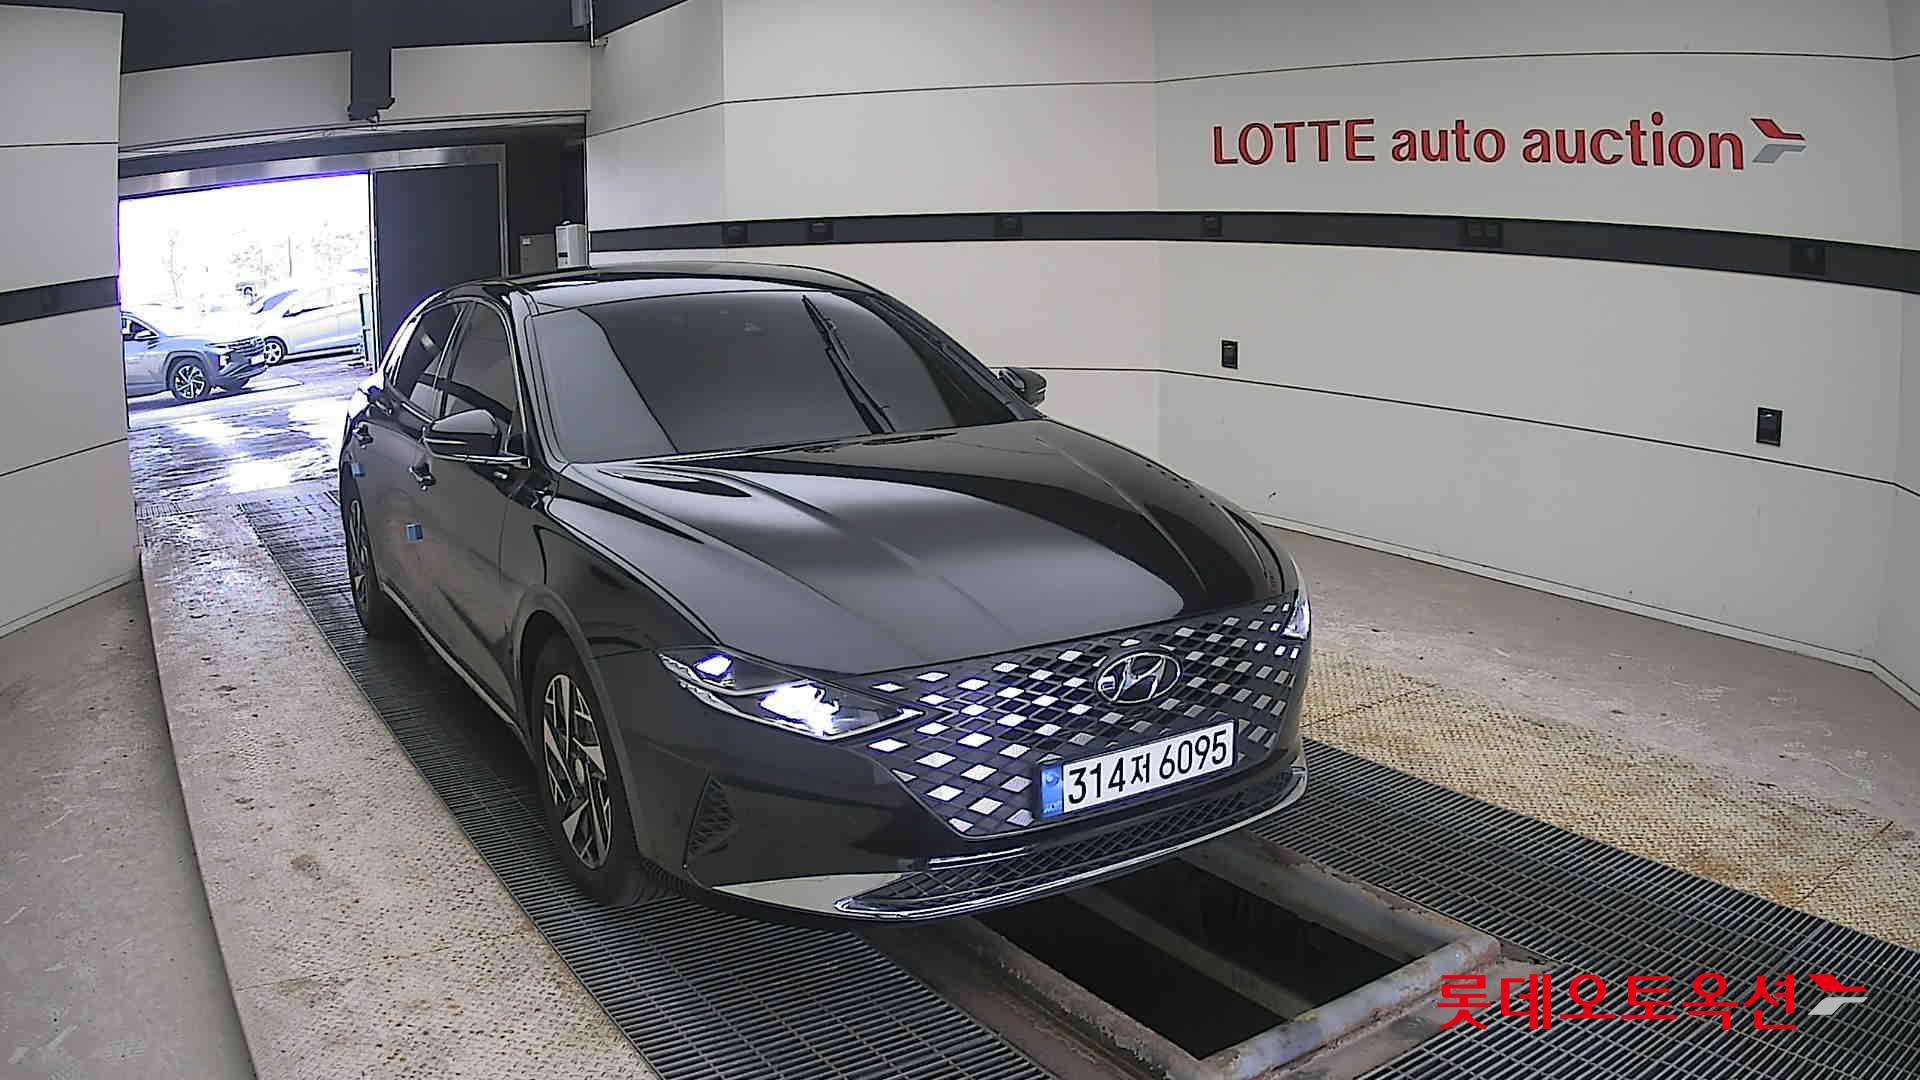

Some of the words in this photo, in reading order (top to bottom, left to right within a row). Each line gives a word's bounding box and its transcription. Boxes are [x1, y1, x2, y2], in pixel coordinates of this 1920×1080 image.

[1213, 118, 1376, 165] LOTTE
[1391, 119, 1506, 163] auto
[1522, 111, 1744, 170] auction
[1068, 752, 1150, 804] 314저
[1159, 730, 1227, 780] 6095
